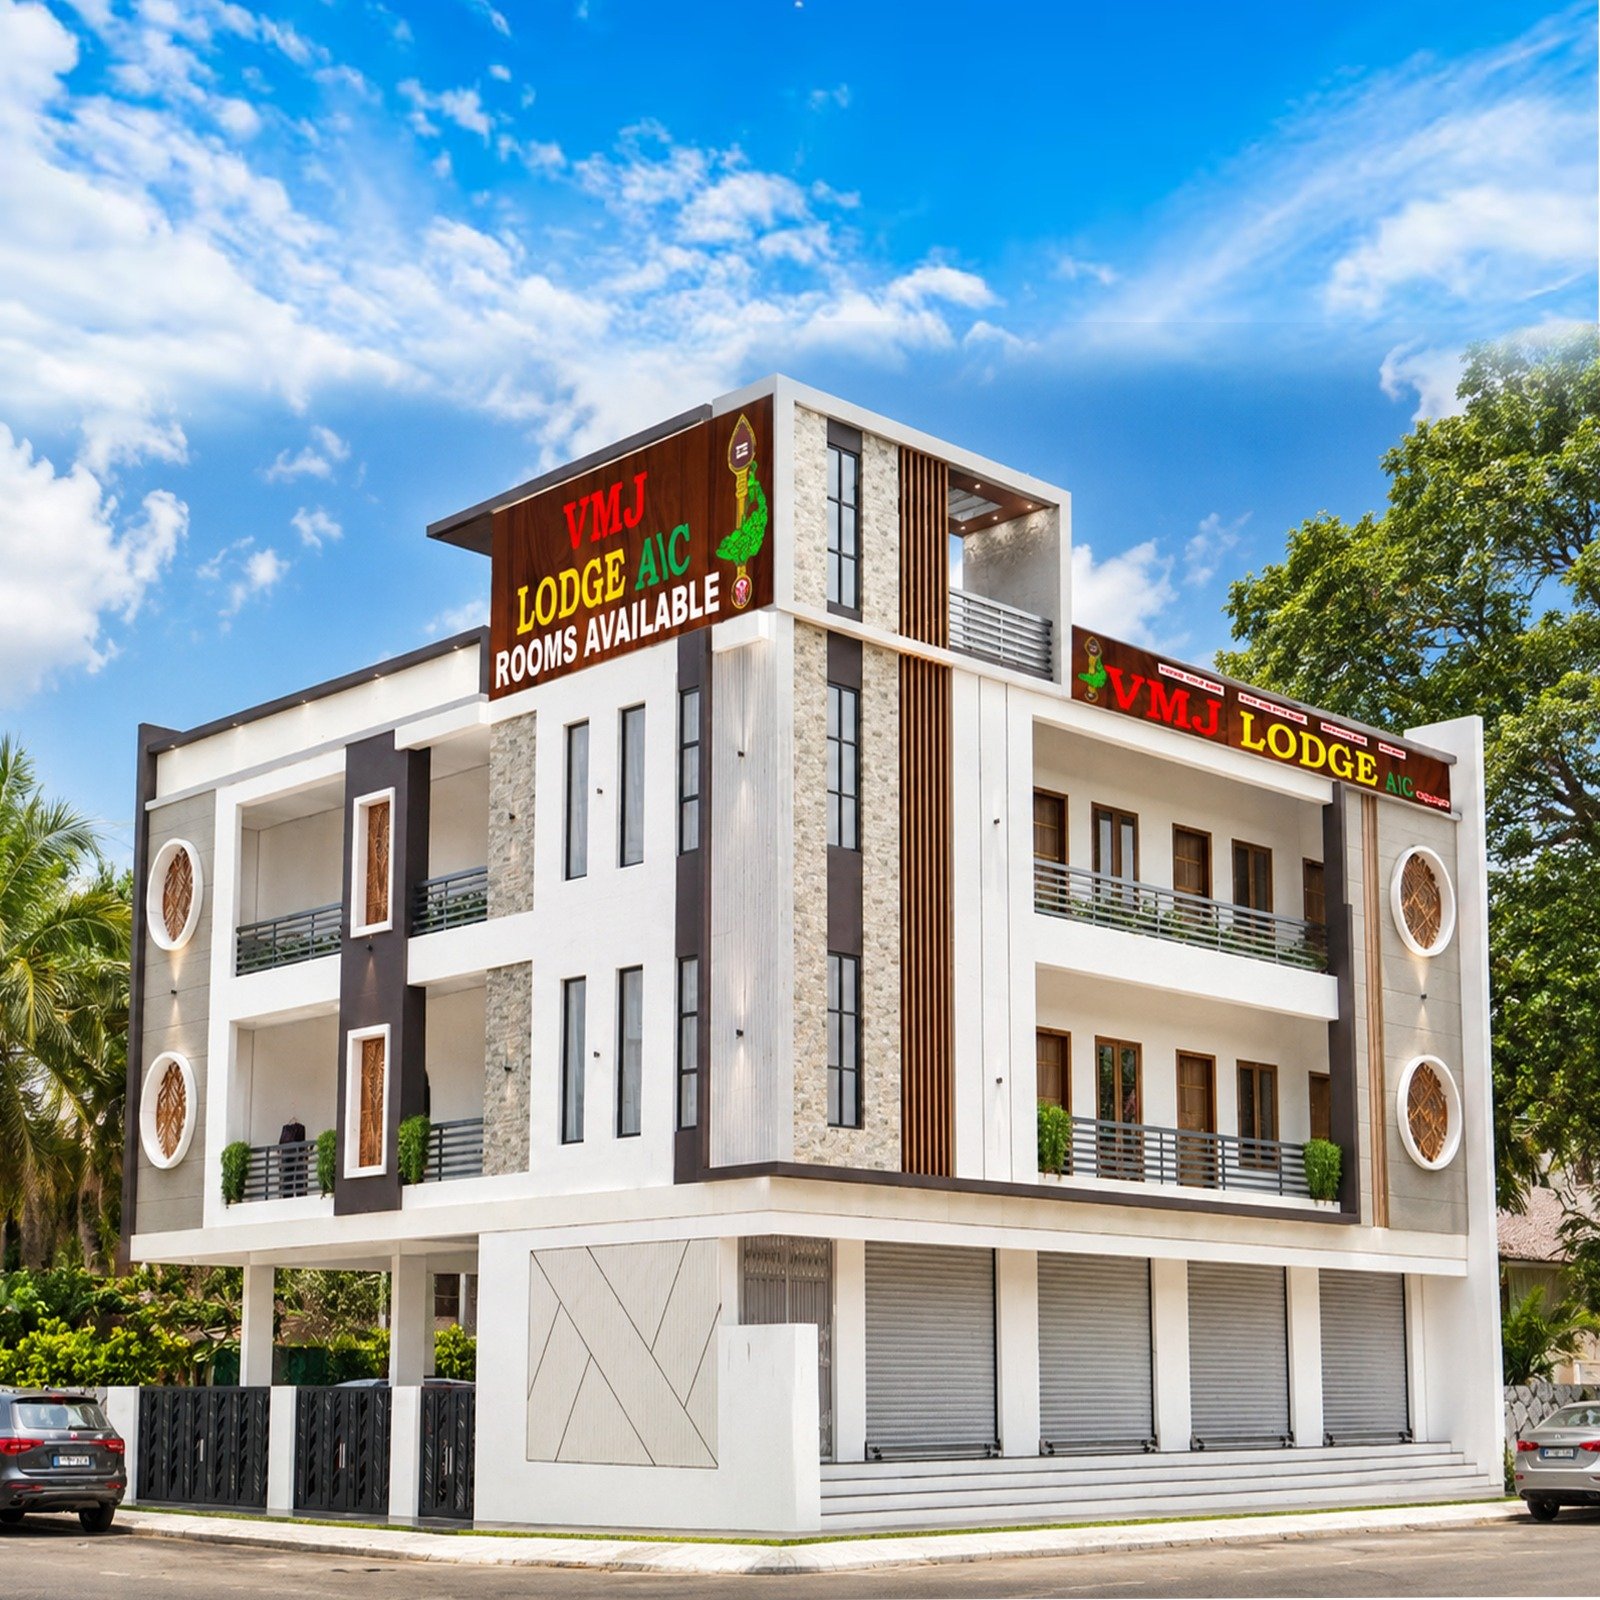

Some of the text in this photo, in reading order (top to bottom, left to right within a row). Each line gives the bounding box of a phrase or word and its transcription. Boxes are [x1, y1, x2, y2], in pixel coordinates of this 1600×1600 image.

[564, 472, 648, 549] VMJ
[495, 571, 720, 689] ROOMS AVAILABLE
[516, 548, 626, 635] LODGE
[1105, 664, 1221, 737] VMJ
[1239, 710, 1379, 787] LODGE
